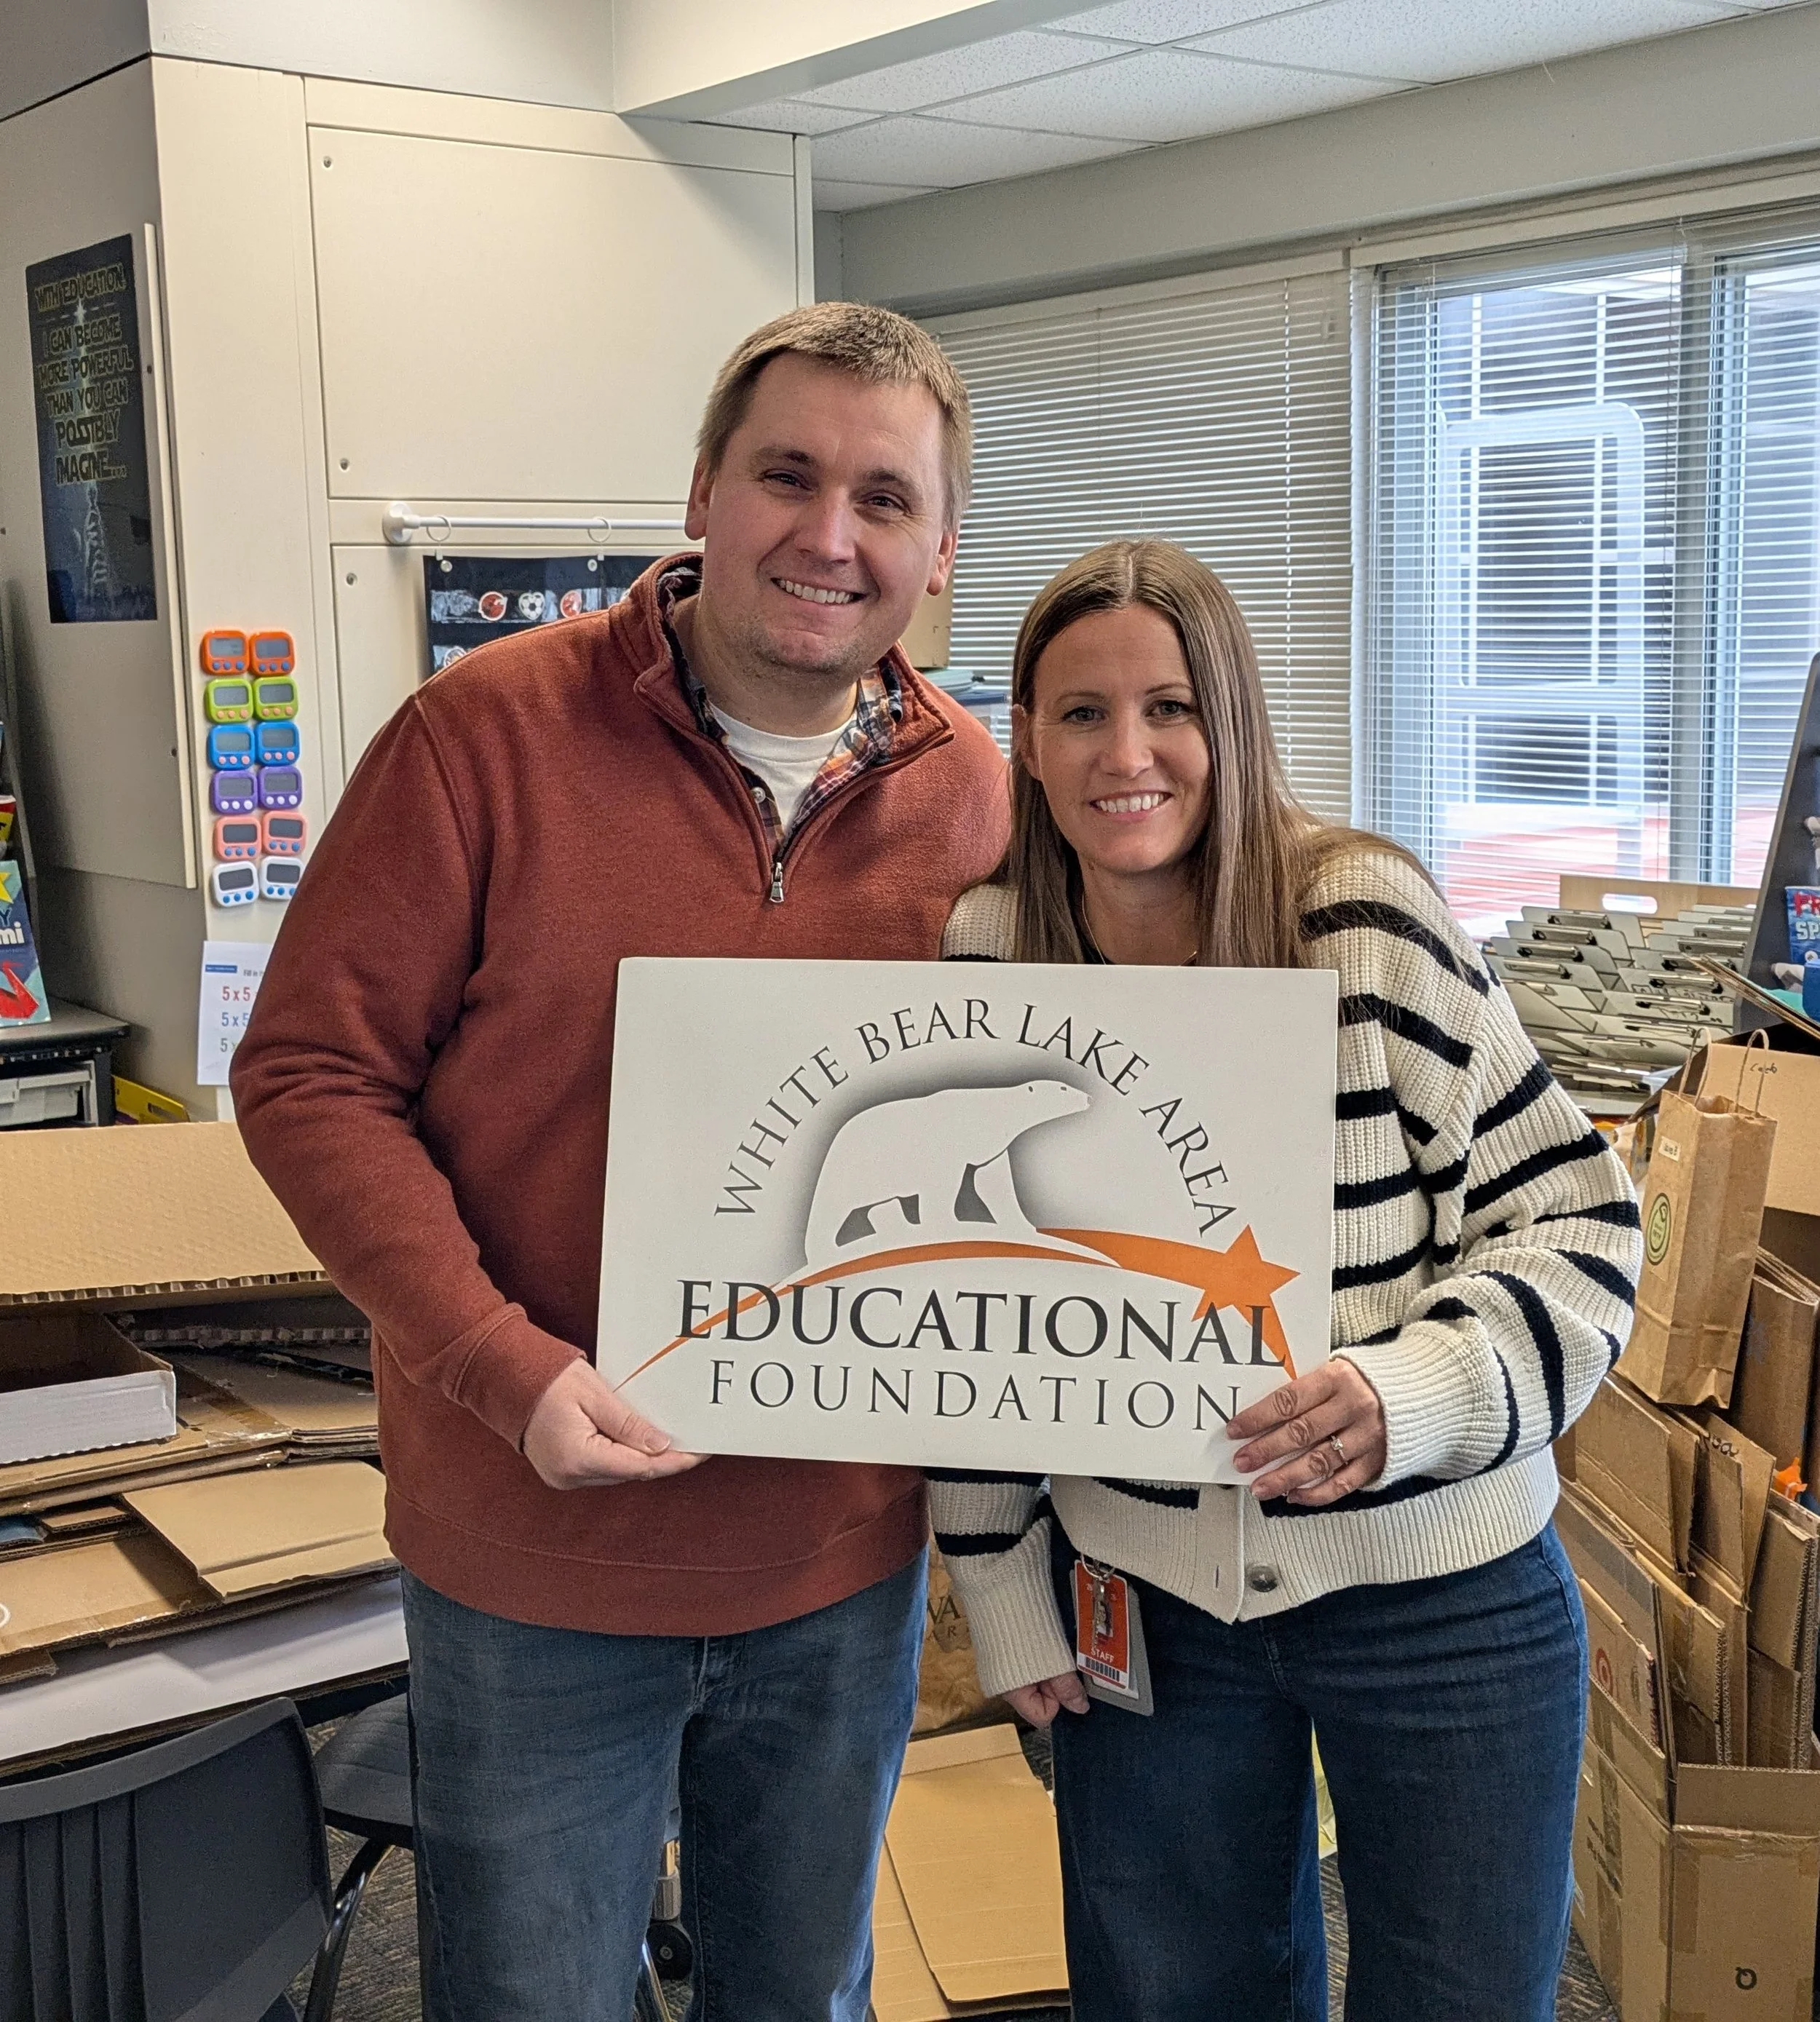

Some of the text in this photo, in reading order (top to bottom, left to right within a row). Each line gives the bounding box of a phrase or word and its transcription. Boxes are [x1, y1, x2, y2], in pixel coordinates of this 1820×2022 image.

[35, 282, 61, 312] WITH
[50, 326, 73, 355] CAN
[74, 312, 122, 347] BECOME
[37, 344, 134, 389] MORE POWERFUL
[46, 376, 129, 419] THAN YOU CAN
[222, 986, 230, 1002] 5
[242, 986, 251, 1002] 5
[221, 1012, 229, 1027] 5
[220, 1038, 228, 1052] 5
[714, 997, 1238, 1237] WHITE BEAR LAKE AREA
[675, 1280, 1286, 1367] EDUCATIONAL
[708, 1361, 1242, 1432] FOUNDATION
[1091, 1647, 1115, 1663] STAFF
